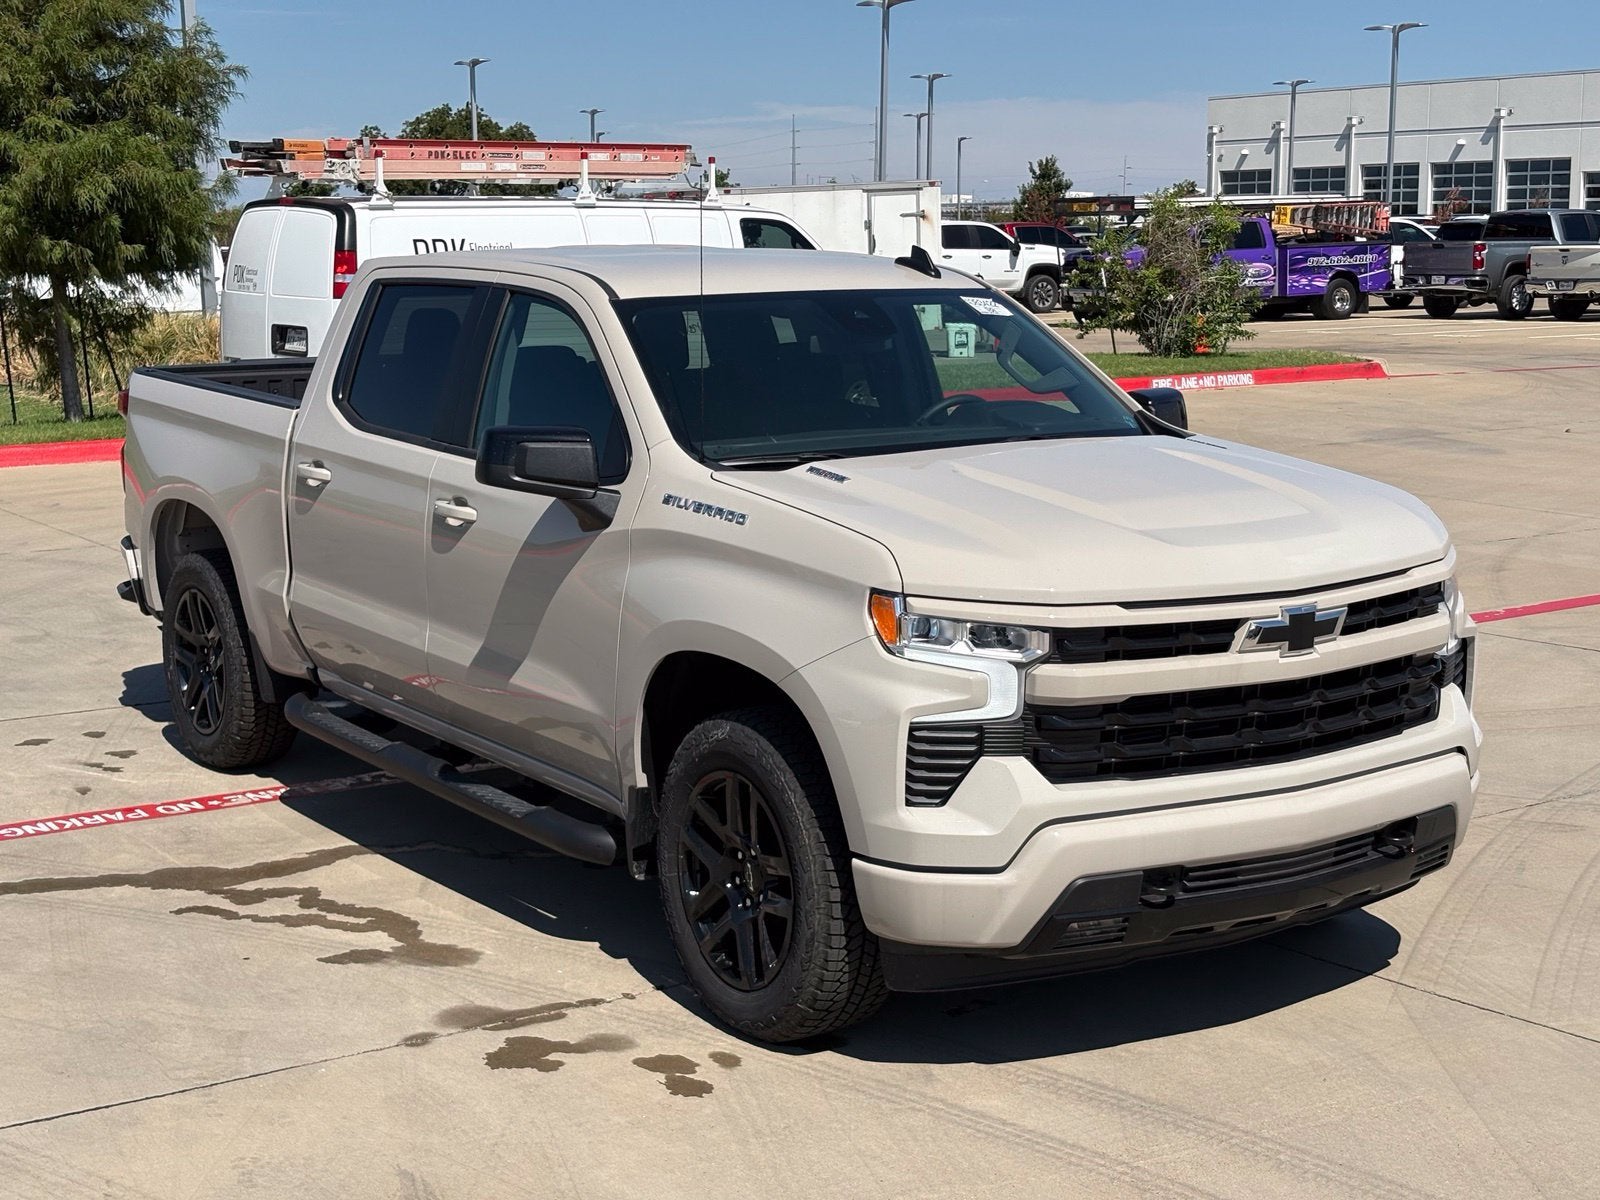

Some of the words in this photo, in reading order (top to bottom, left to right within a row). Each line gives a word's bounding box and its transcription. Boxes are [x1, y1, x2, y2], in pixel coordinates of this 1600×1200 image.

[452, 150, 477, 159] ELEC
[1152, 378, 1173, 389] FIRE
[1175, 377, 1199, 390] LANE
[1203, 376, 1216, 387] NO
[1217, 373, 1254, 387] PARKING
[661, 492, 749, 527] SILVERADO
[155, 800, 205, 815] NO
[0, 808, 150, 837] PARKING
